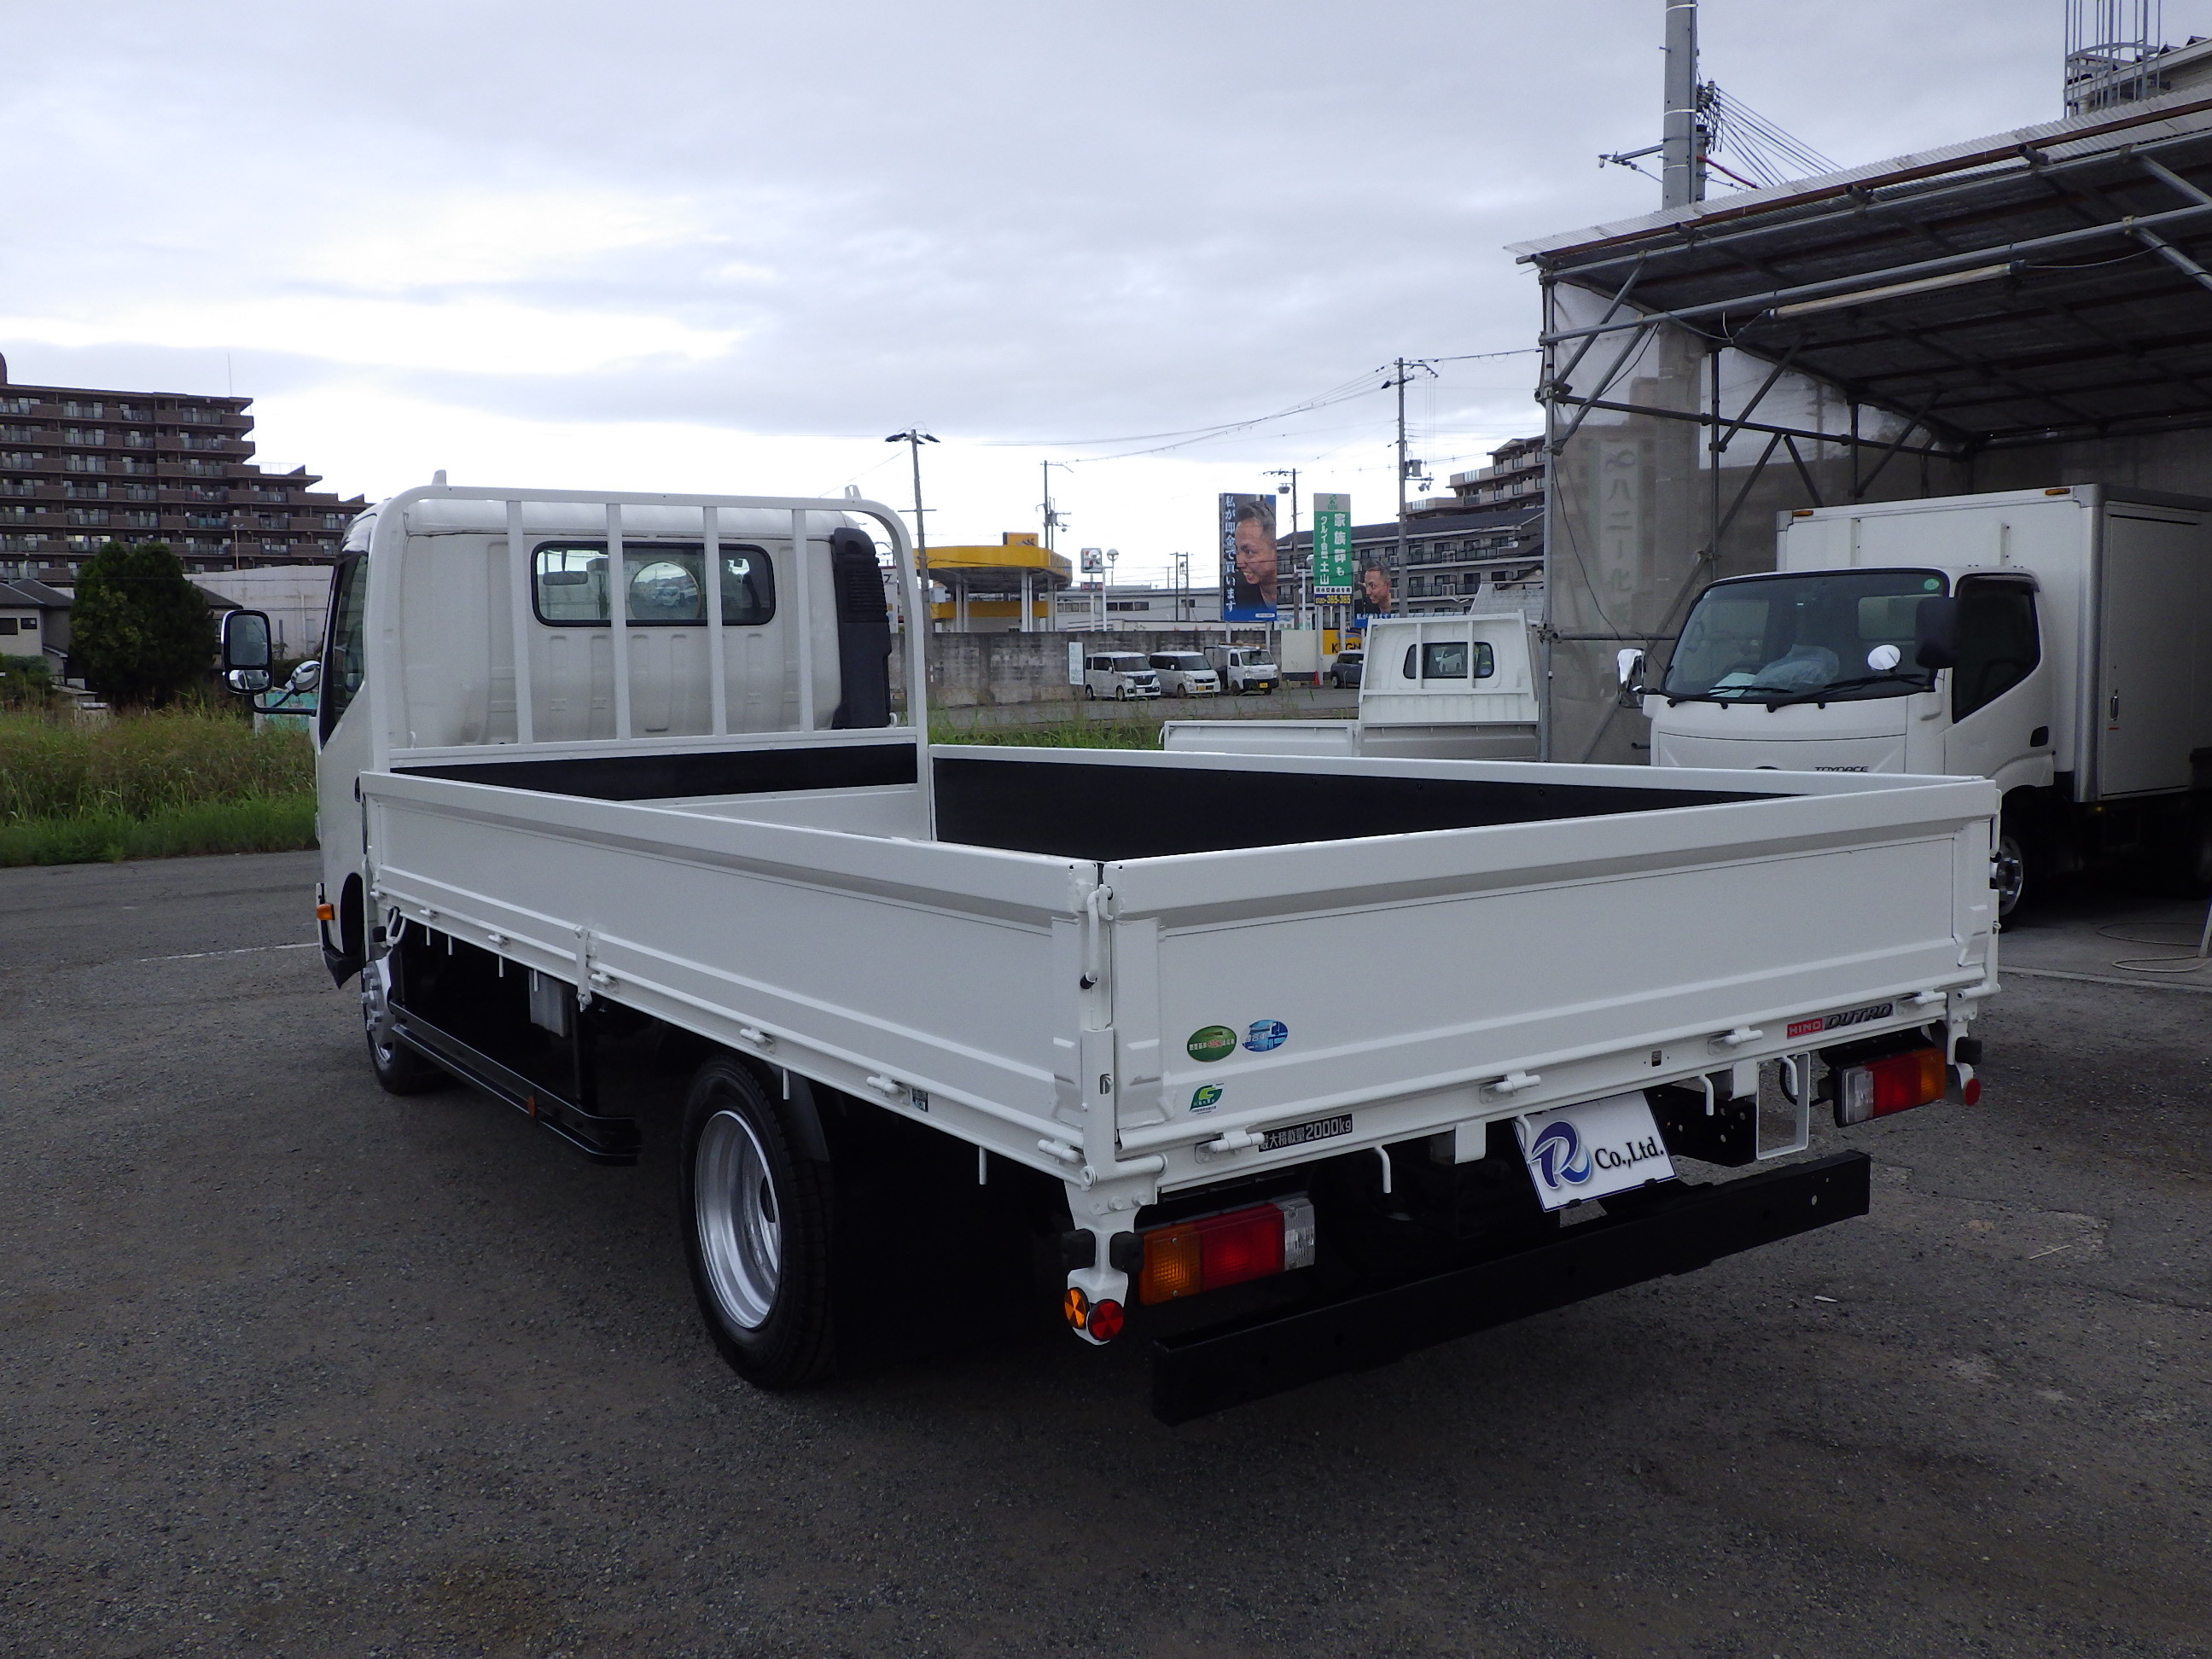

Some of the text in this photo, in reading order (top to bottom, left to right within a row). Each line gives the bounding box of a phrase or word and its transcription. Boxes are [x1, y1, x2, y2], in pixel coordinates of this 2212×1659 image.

[1225, 495, 1236, 613] 私が即金で買います
[1789, 1003, 1893, 1035] HINO DUTRO
[1594, 1136, 1664, 1169] Co.,Ltd.
